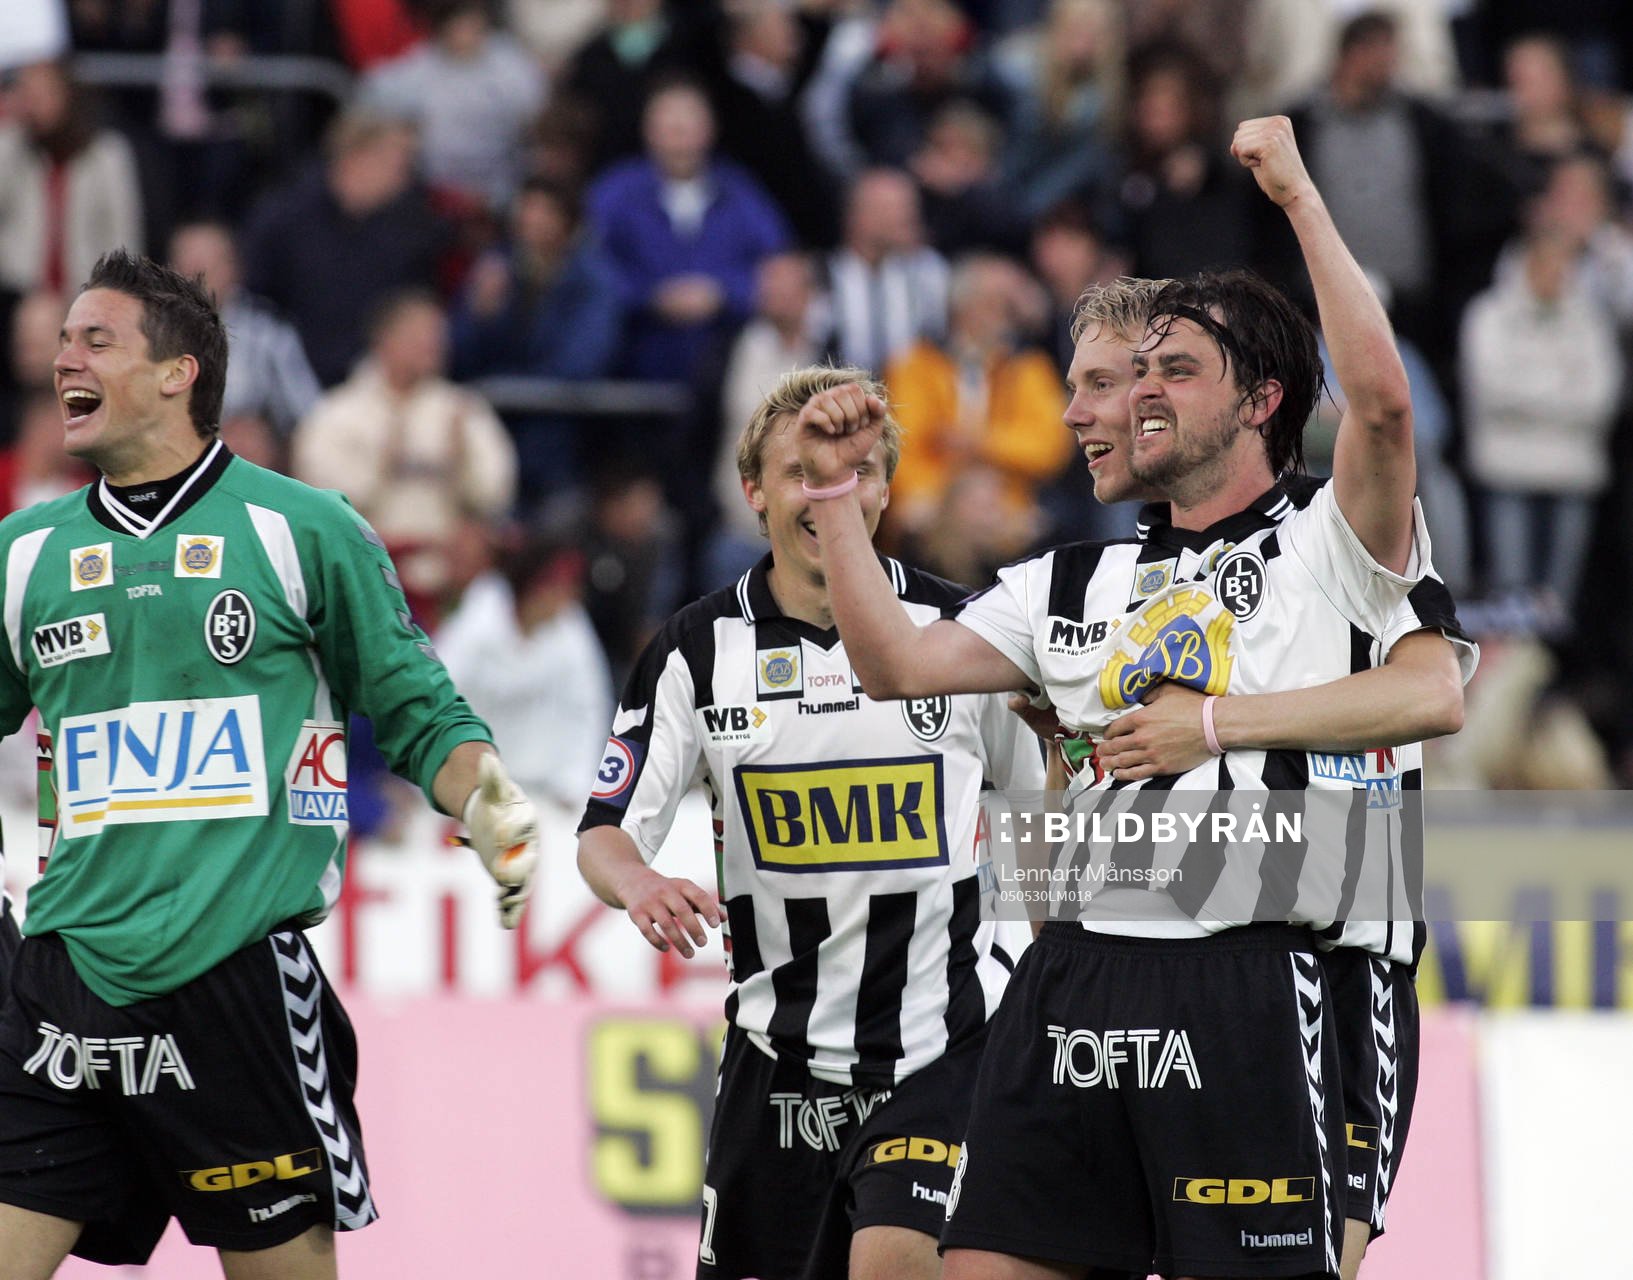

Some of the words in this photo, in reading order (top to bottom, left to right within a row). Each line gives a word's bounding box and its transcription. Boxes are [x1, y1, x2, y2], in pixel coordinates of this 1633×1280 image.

[126, 584, 163, 599] TOFTA
[35, 621, 83, 656] MVB
[1049, 620, 1108, 648] MVB
[808, 674, 846, 687] TOFTA
[798, 697, 860, 715] hummel
[757, 781, 928, 847] BMK
[23, 1021, 196, 1096] TOFTA
[1047, 1025, 1202, 1089] TOFTA
[189, 1154, 312, 1192] GDL
[912, 1182, 948, 1206] hum
[1185, 1178, 1304, 1204] GDL
[1241, 1228, 1312, 1247] hummel
